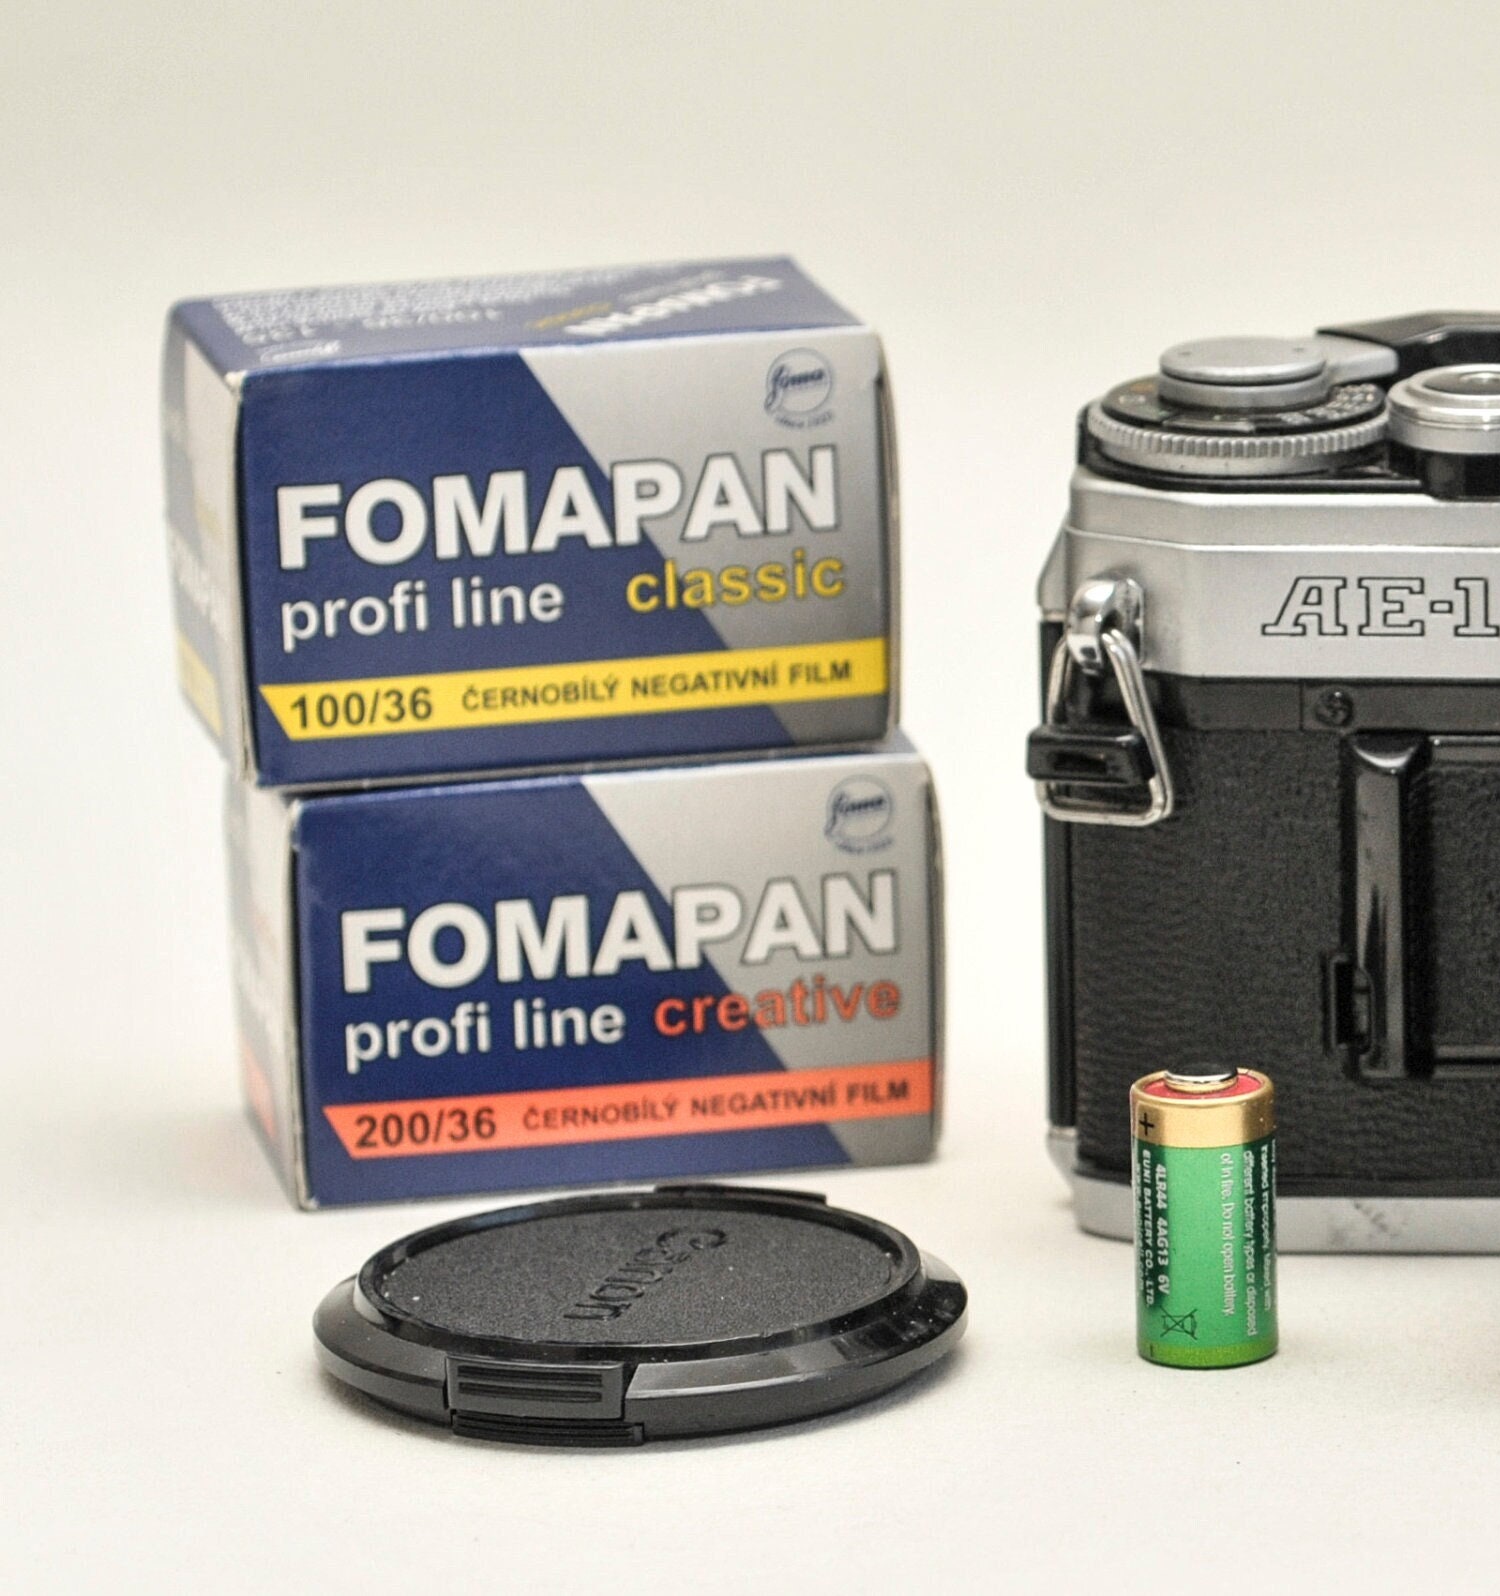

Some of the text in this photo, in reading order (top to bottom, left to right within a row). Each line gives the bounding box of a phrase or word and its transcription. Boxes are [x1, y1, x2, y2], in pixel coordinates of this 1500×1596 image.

[275, 445, 839, 571] FOMAPAN
[281, 549, 847, 652] profi line classic
[1261, 575, 1500, 638] AE-1
[290, 658, 853, 731] 100/36 ČERNOBÍLÝ NEGATIVNÍ FILM
[340, 870, 898, 994] FOMAPAN
[345, 976, 902, 1075] profi line creative
[355, 1079, 910, 1150] 200/36 ČERNOBÍLÝ NEGATIVNÍ FILM
[1142, 1149, 1152, 1182] EUNI
[1142, 1188, 1152, 1246] BATTERY
[1156, 1164, 1170, 1296] 4LR44 4AG13 6V
[1222, 1203, 1236, 1219] Do
[1220, 1244, 1236, 1272] open
[1244, 1286, 1259, 1336] disposed
